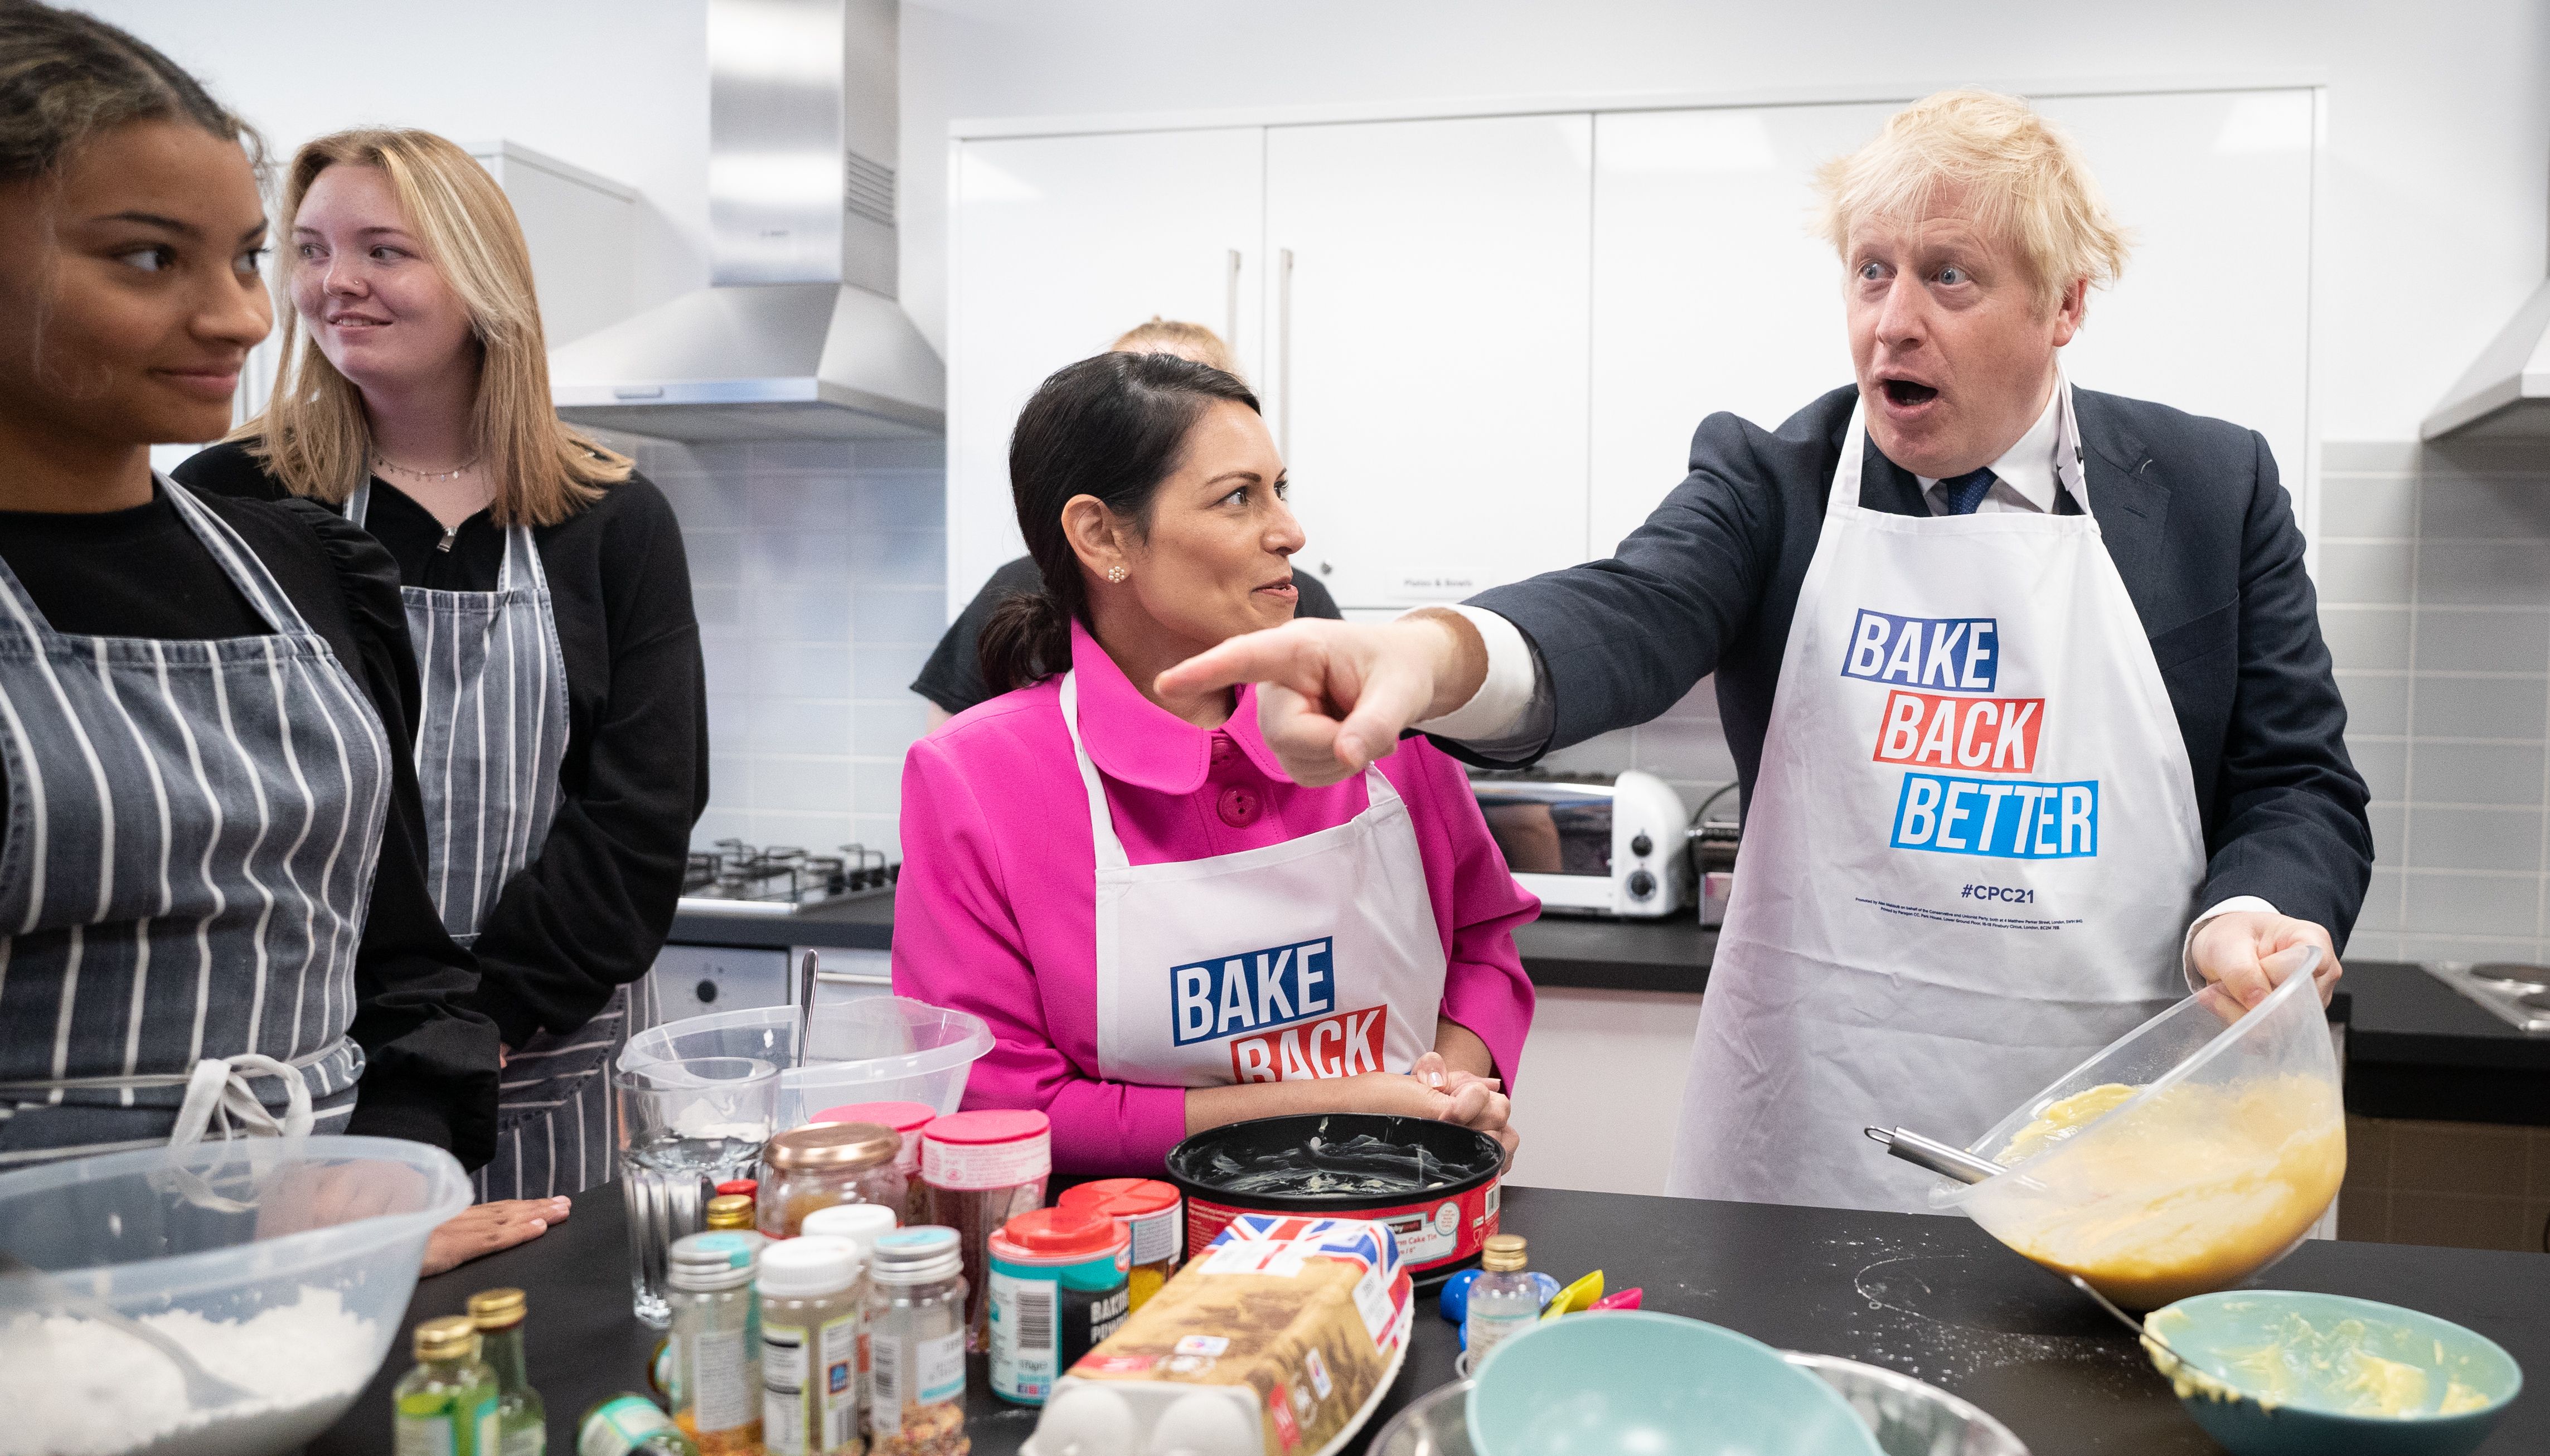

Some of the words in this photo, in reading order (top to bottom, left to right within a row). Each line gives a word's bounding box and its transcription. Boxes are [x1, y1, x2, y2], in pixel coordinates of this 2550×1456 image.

[1848, 613, 1994, 688] BAKE
[1880, 694, 2039, 769] BACK
[1897, 776, 2093, 855] BETTER
[1961, 884, 2034, 903] #CPC21
[1176, 941, 1327, 1041] BAKE
[1237, 1009, 1380, 1083] BACK
[1408, 1235, 1426, 1245] Cake
